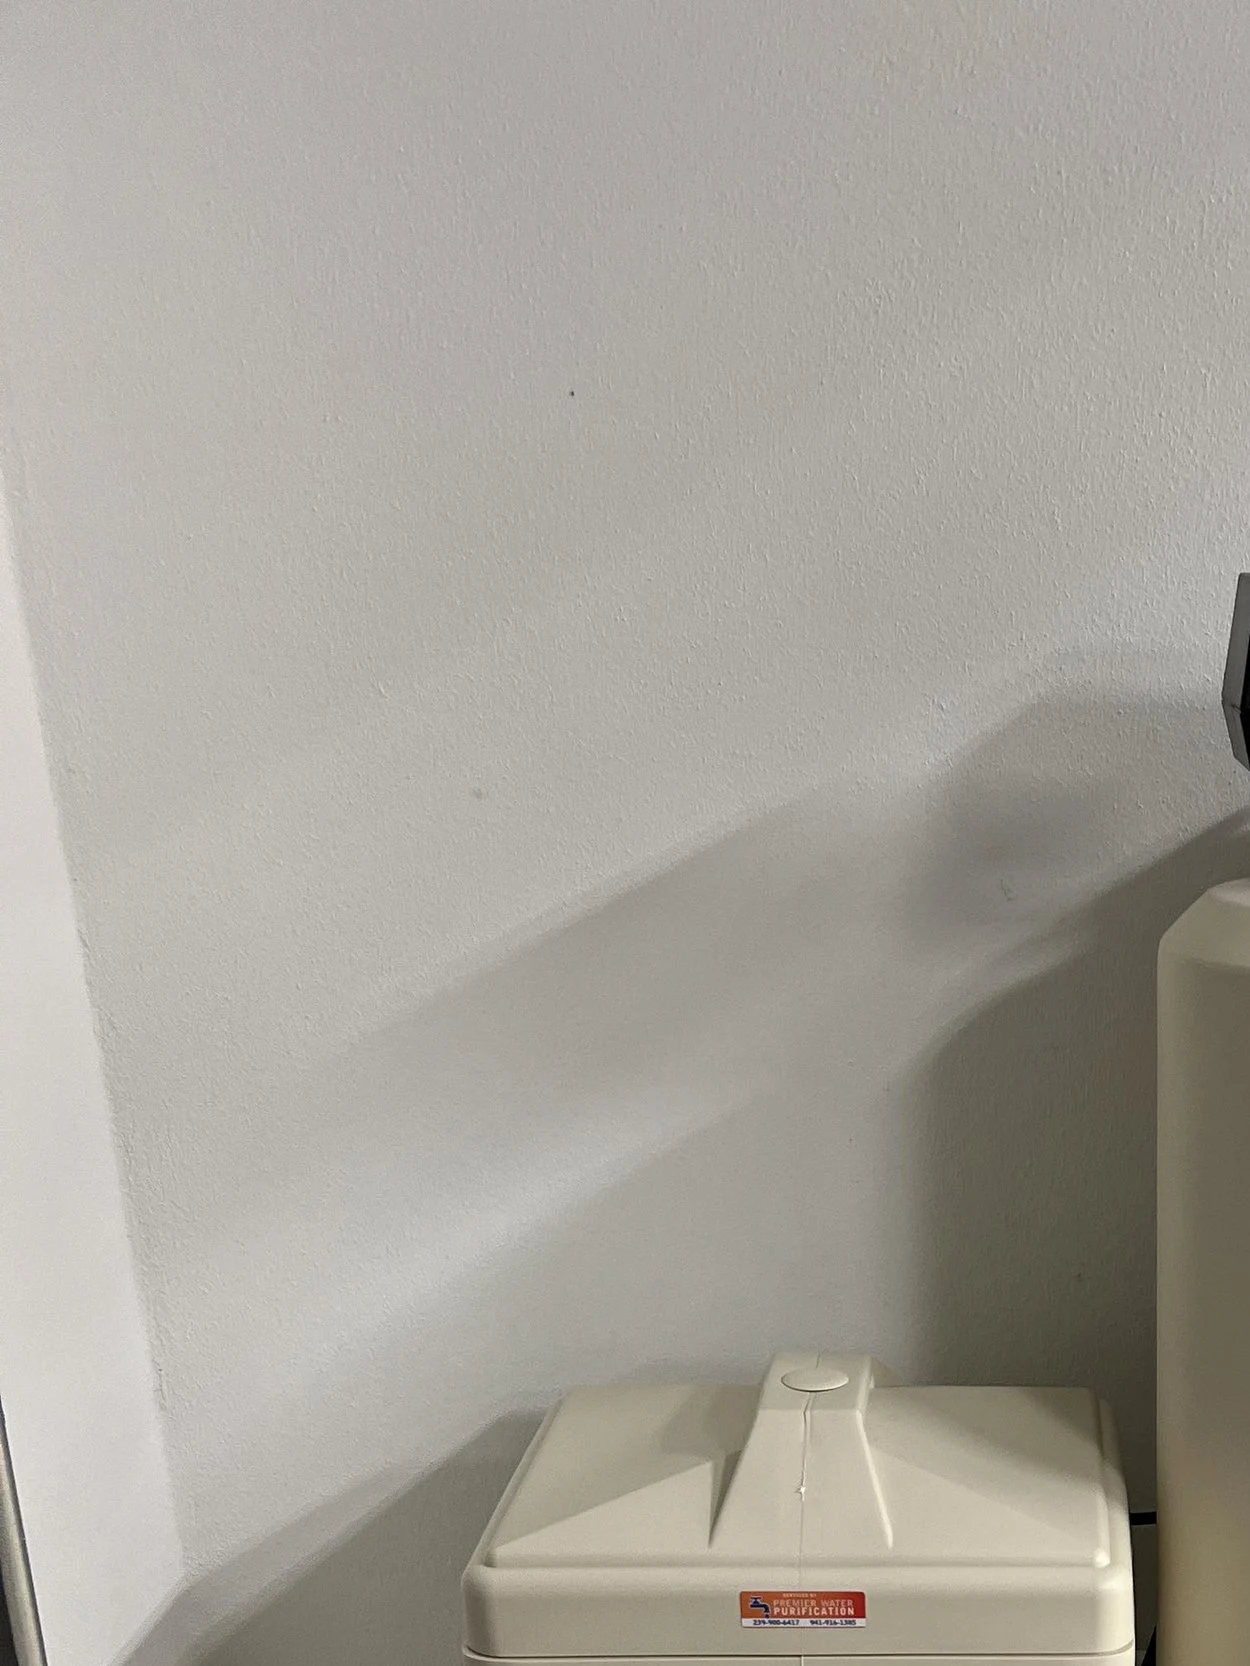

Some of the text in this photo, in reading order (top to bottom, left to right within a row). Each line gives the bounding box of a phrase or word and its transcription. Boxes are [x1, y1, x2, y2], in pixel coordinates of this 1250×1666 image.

[773, 1599, 854, 1607] PREMIER WATER
[773, 1606, 855, 1616] PURIFICATION
